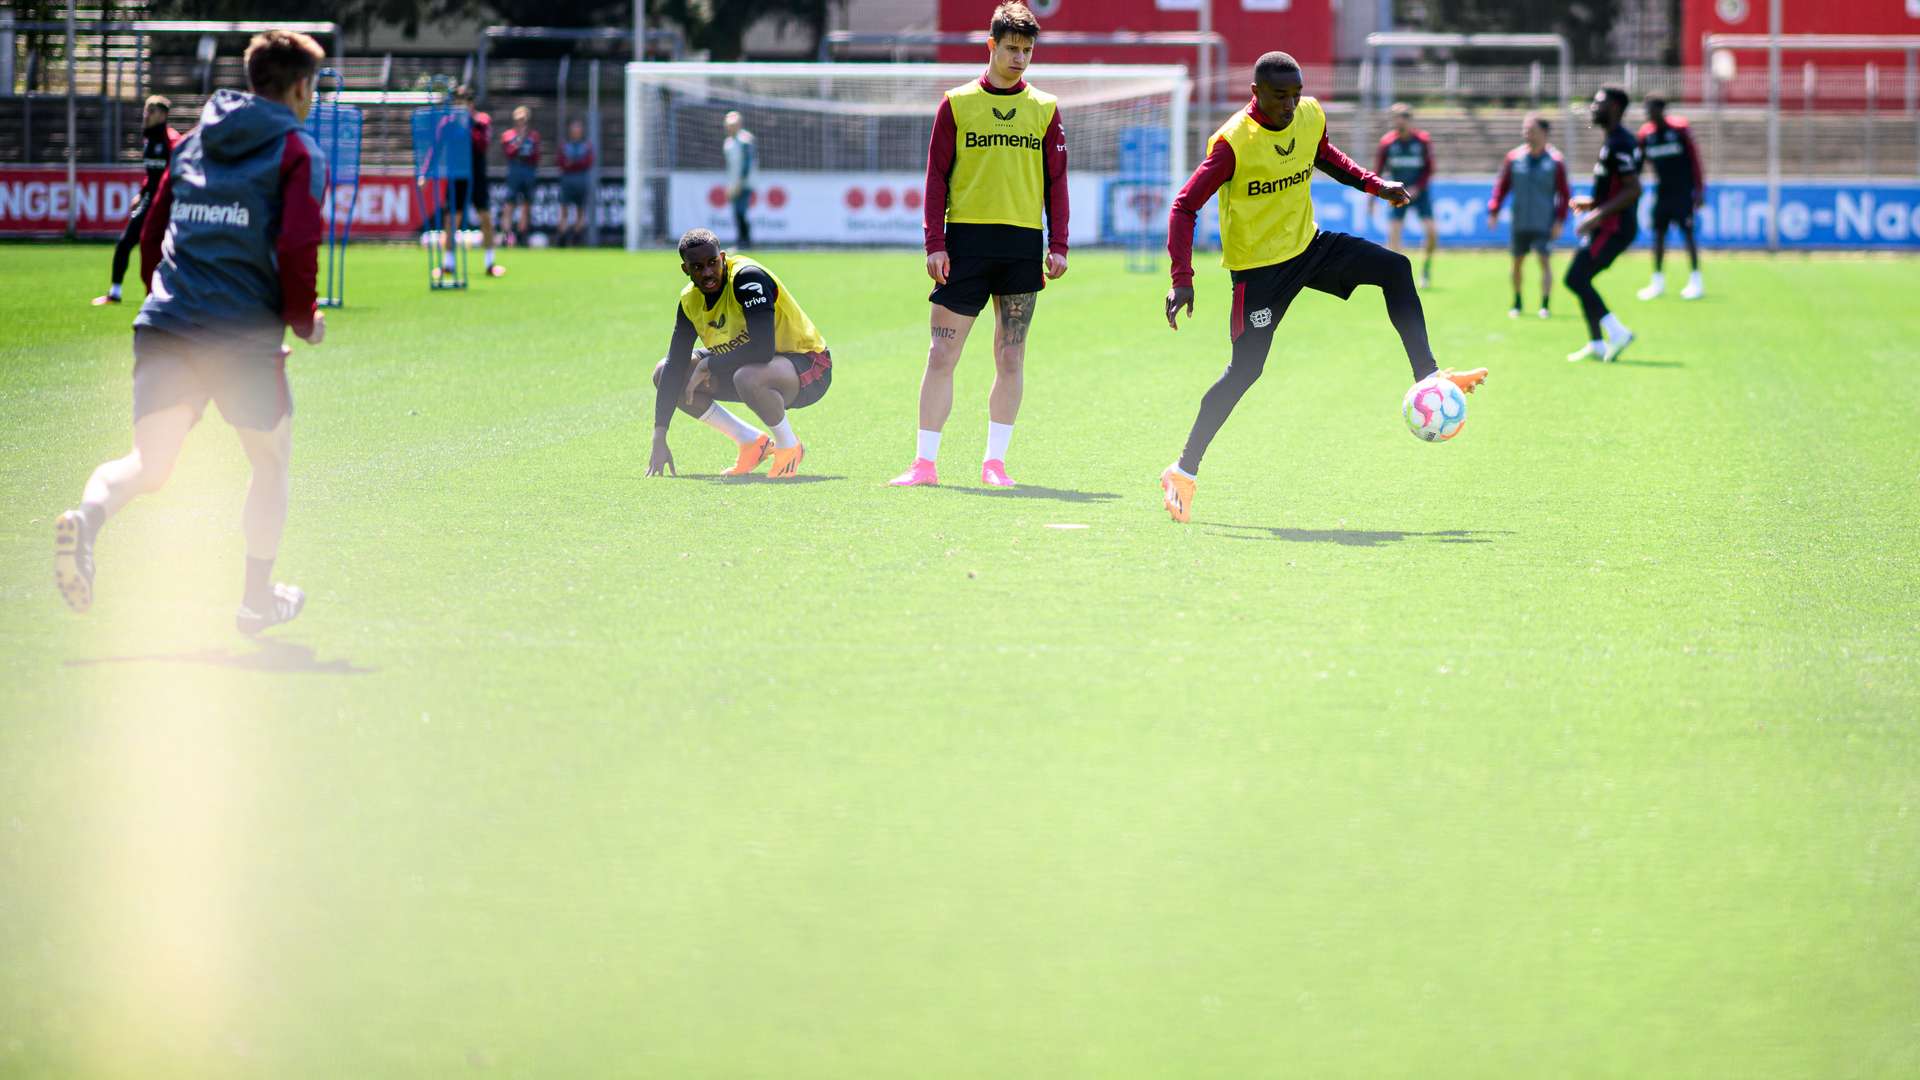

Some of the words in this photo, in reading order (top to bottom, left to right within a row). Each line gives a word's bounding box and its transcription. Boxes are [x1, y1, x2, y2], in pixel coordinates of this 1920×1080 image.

[965, 132, 1041, 151] Barmenia
[1247, 163, 1314, 197] Barmeni
[104, 181, 141, 221] D
[744, 296, 767, 308] trive
[707, 329, 750, 354] armeni
